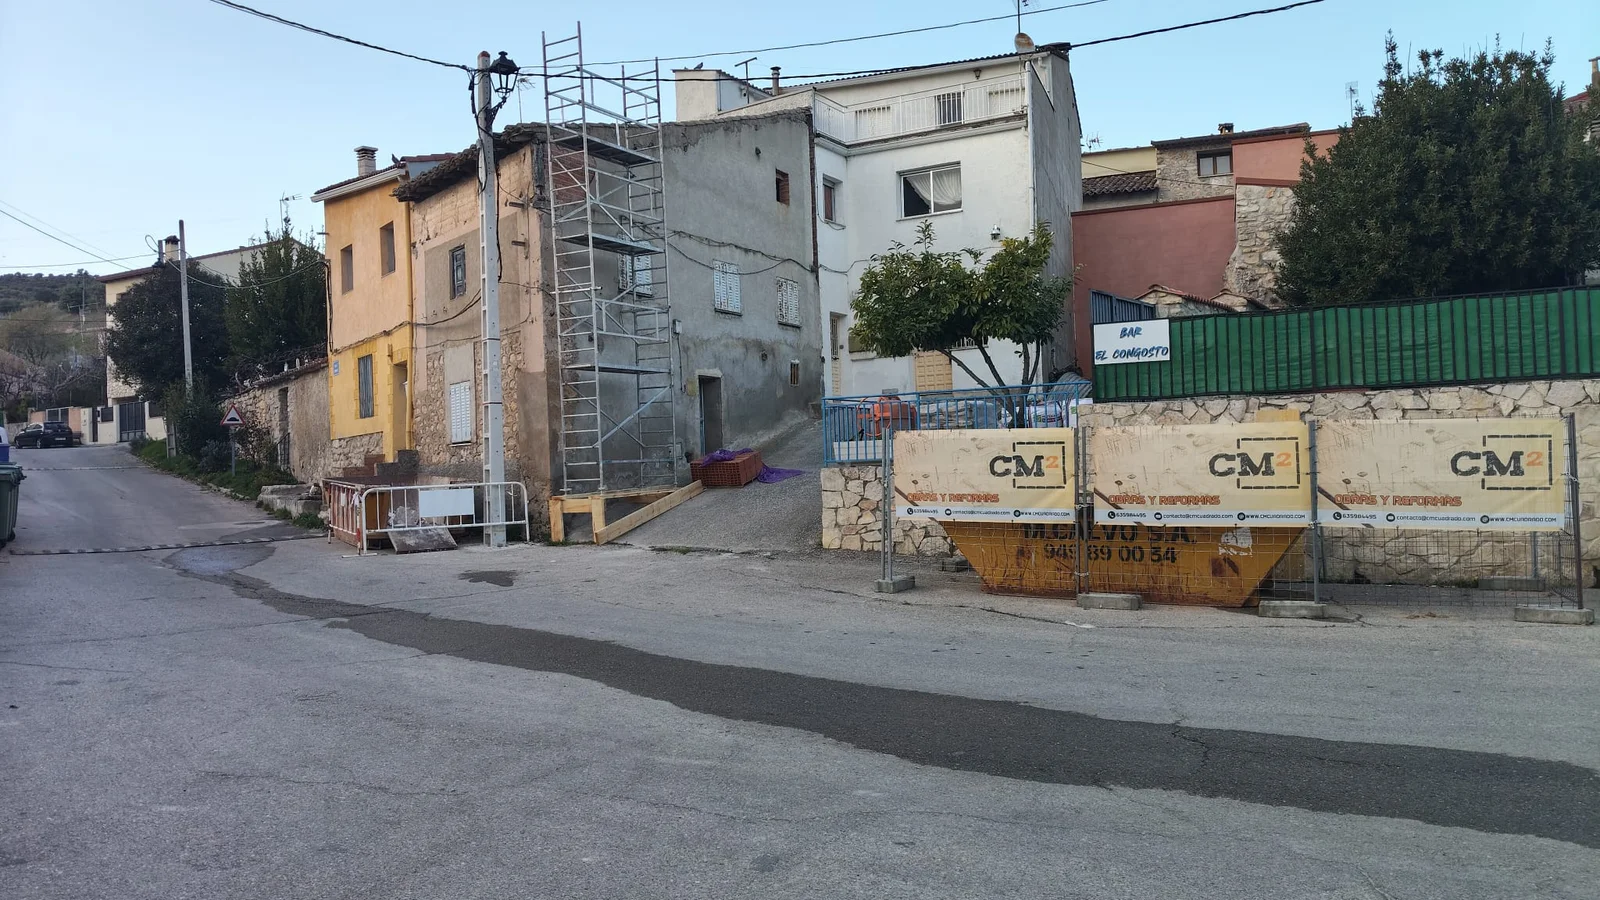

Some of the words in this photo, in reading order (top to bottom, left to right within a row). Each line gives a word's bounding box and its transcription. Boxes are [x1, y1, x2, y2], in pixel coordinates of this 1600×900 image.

[1120, 326, 1142, 338] BAR
[1095, 350, 1108, 360] EL
[1112, 346, 1168, 360] CONGOSTO
[939, 494, 946, 502] Y
[1108, 494, 1146, 504] OBRAS
[1148, 495, 1156, 505] Y
[1159, 495, 1221, 506] REFORMAS
[1334, 494, 1378, 506] OBRAS
[1380, 495, 1390, 506] Y
[1392, 495, 1463, 507] REFORMAS
[1118, 545, 1145, 562] 00
